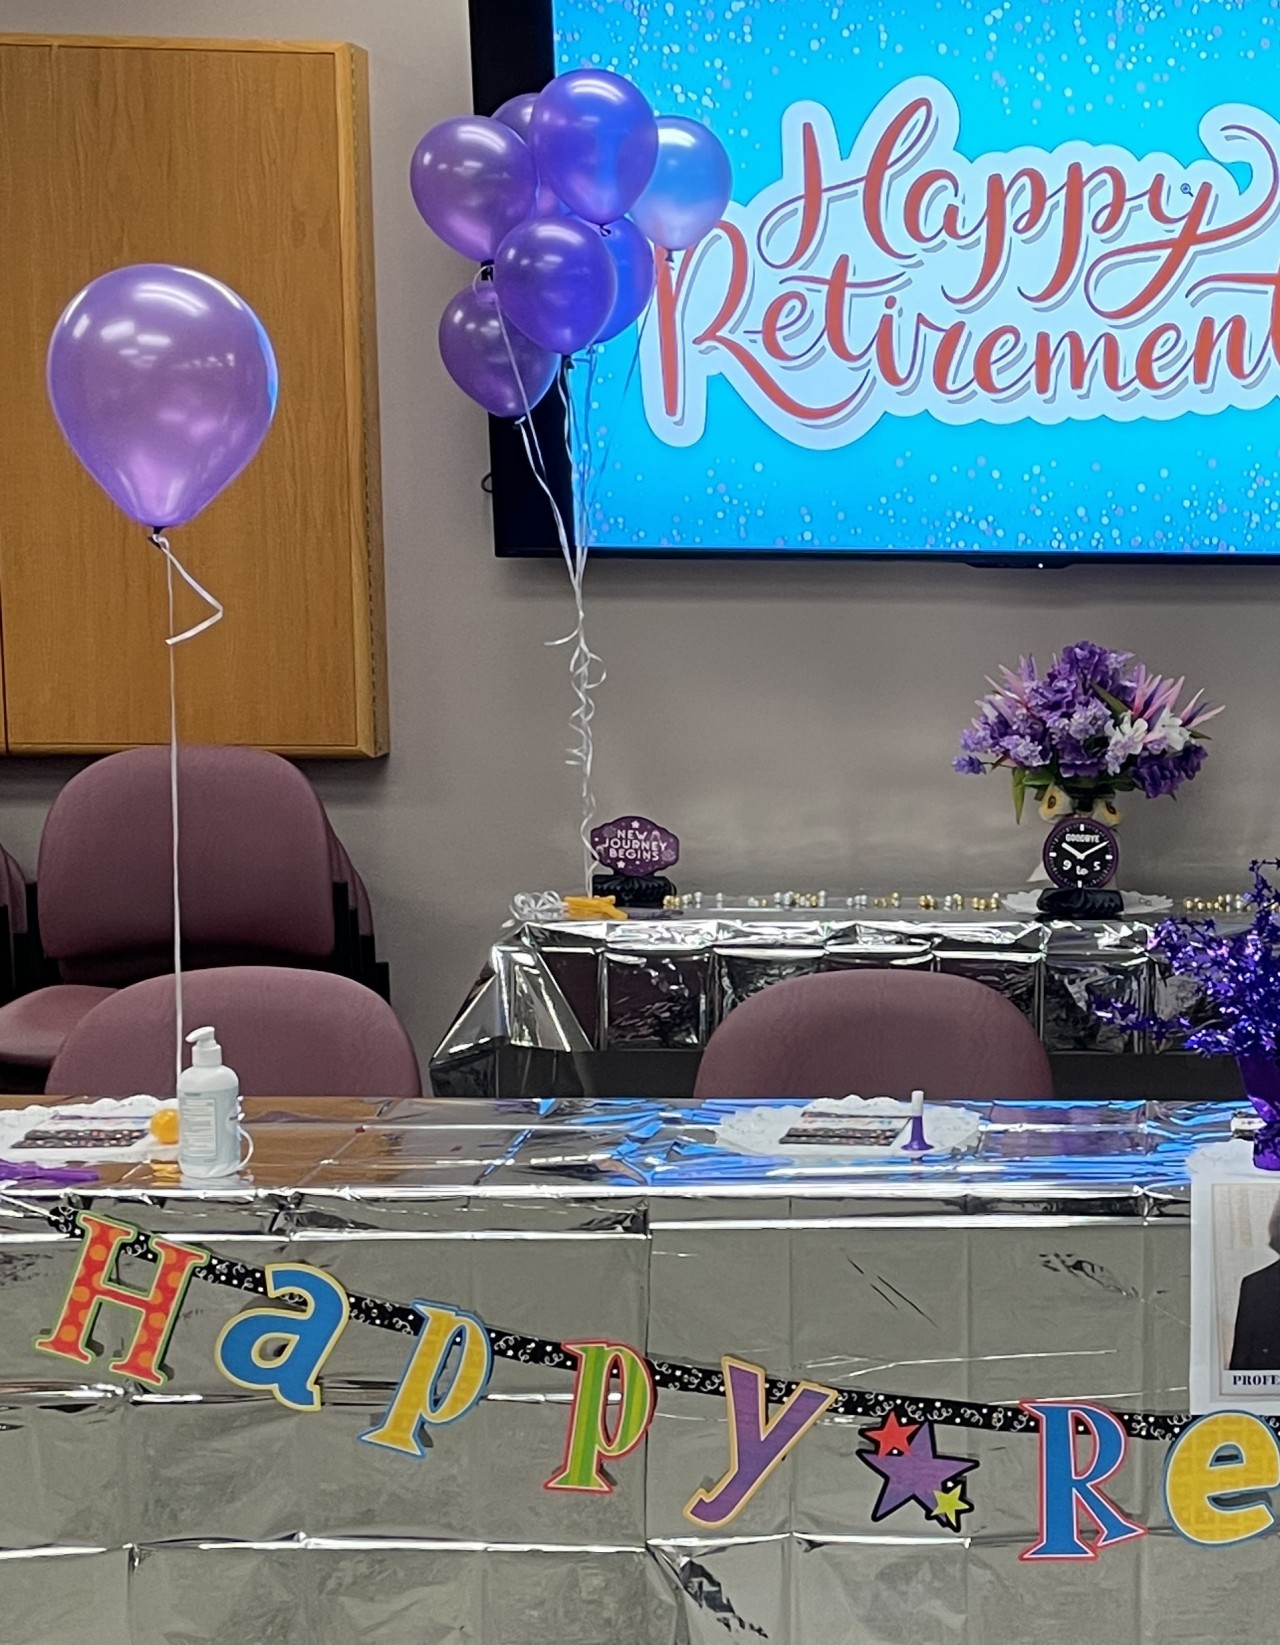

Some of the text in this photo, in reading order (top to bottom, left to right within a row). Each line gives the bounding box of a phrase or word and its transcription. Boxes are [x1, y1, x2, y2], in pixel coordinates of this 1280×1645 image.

[617, 829, 648, 840] NEW
[1065, 834, 1100, 843] GOODBYE
[602, 838, 668, 851] JOURNEY
[609, 849, 660, 861] BEGINS
[1062, 860, 1101, 876] 9 to 5
[34, 1209, 839, 1529] Happy
